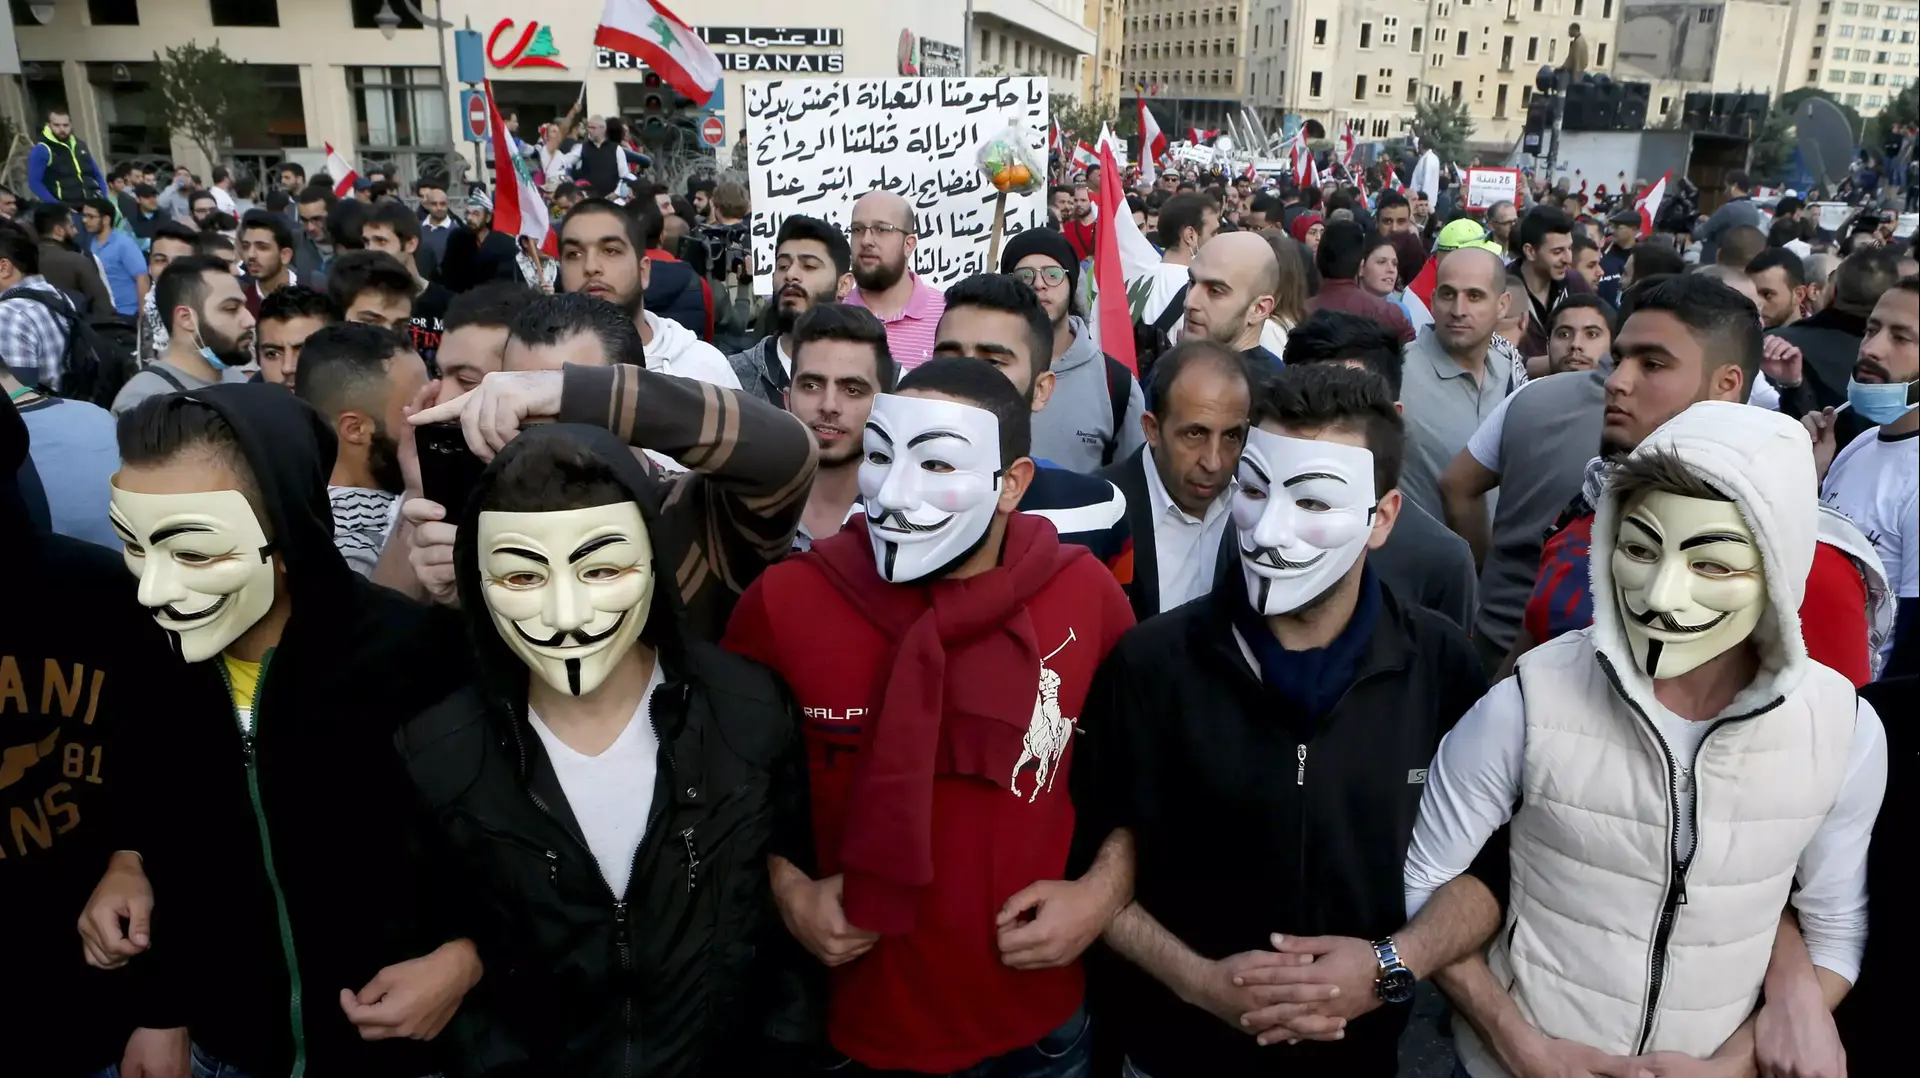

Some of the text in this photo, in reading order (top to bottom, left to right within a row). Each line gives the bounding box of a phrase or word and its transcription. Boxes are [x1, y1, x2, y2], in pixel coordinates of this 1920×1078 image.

[726, 27, 842, 47] الاعتماد
[596, 50, 843, 72] CRE IBANAIS
[856, 79, 933, 120] التعبانة
[941, 76, 1019, 115] حكومتنا
[1027, 78, 1042, 116] يا
[842, 122, 899, 154] قتلتنا
[906, 122, 978, 162] الزبالة
[766, 169, 804, 198] عنا
[803, 706, 868, 720] RALP
[63, 742, 103, 784] 81
[0, 782, 81, 859] NS
